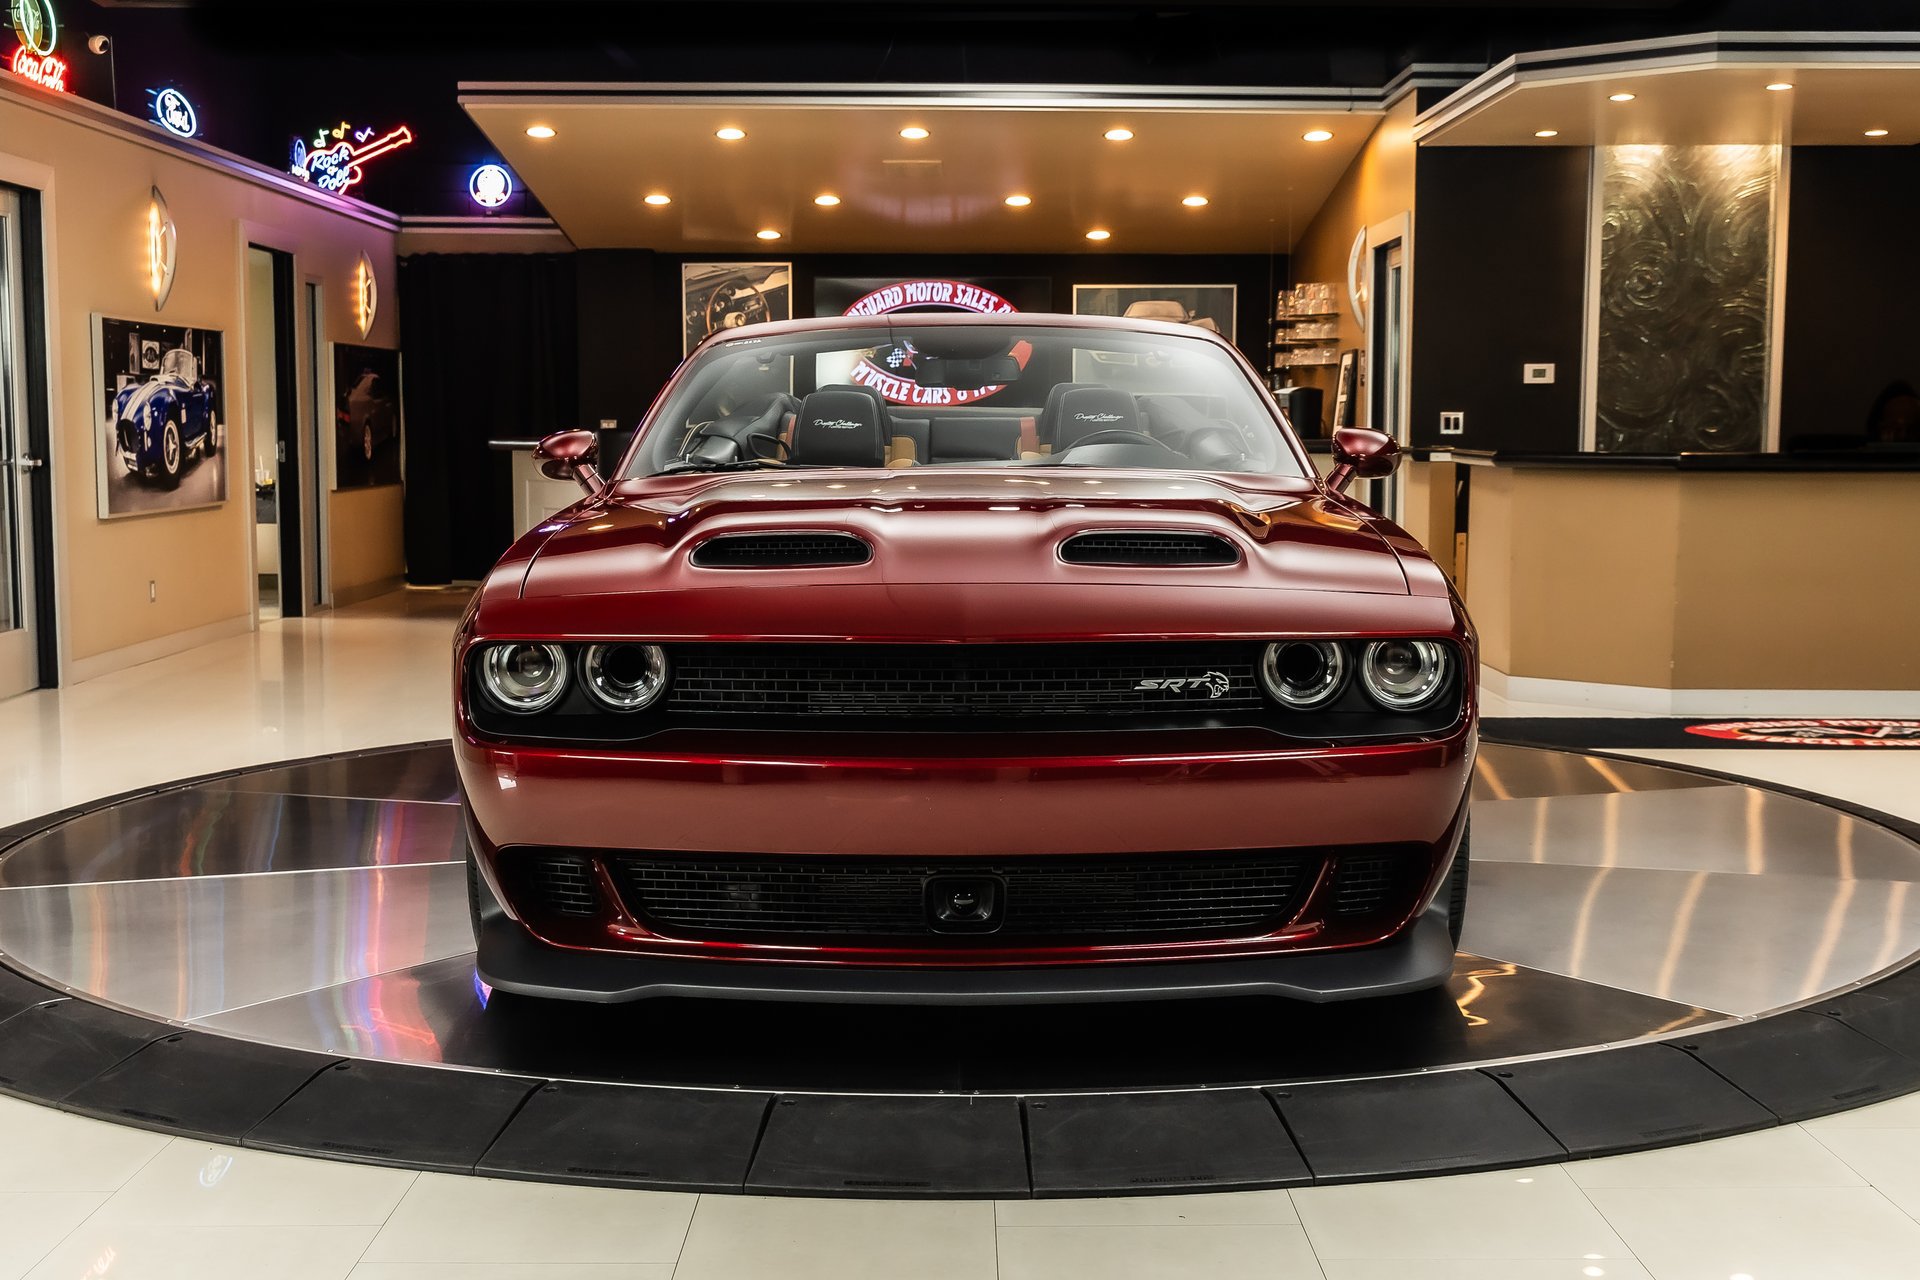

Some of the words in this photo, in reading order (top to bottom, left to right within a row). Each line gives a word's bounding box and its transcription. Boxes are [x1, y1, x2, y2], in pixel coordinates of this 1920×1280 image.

[310, 145, 350, 172] Rock
[904, 282, 953, 303] MOTOR
[850, 361, 910, 401] MUSCLE
[912, 384, 952, 404] CARS
[1133, 678, 1212, 693] SRT
